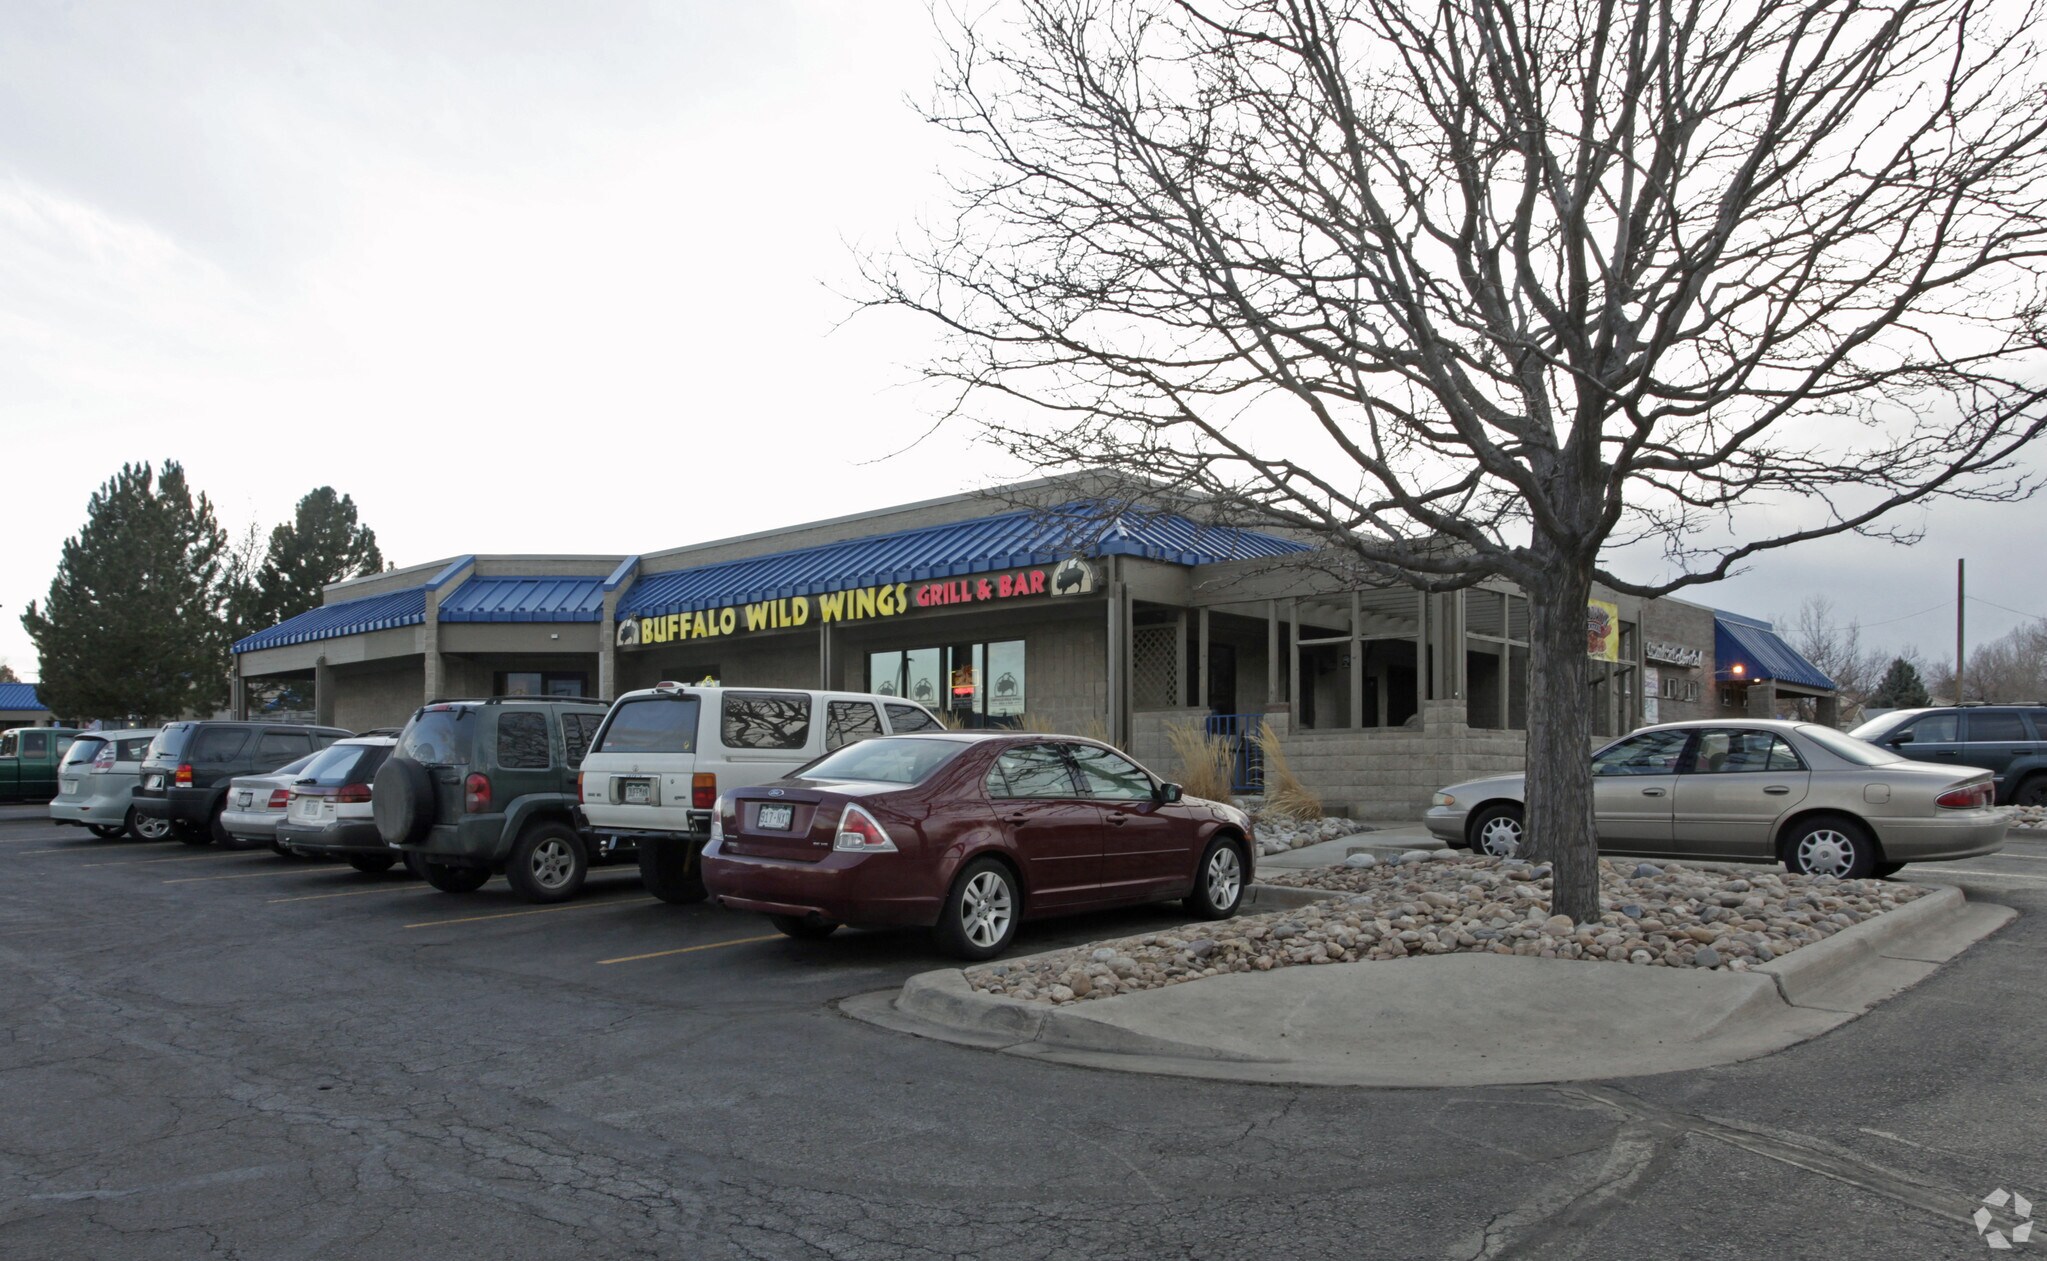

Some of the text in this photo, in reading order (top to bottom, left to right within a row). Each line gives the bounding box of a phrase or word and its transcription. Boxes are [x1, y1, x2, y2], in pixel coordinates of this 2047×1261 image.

[641, 582, 908, 644] BUFFALO WILD WINGS
[916, 569, 1046, 607] GRILL & BAR
